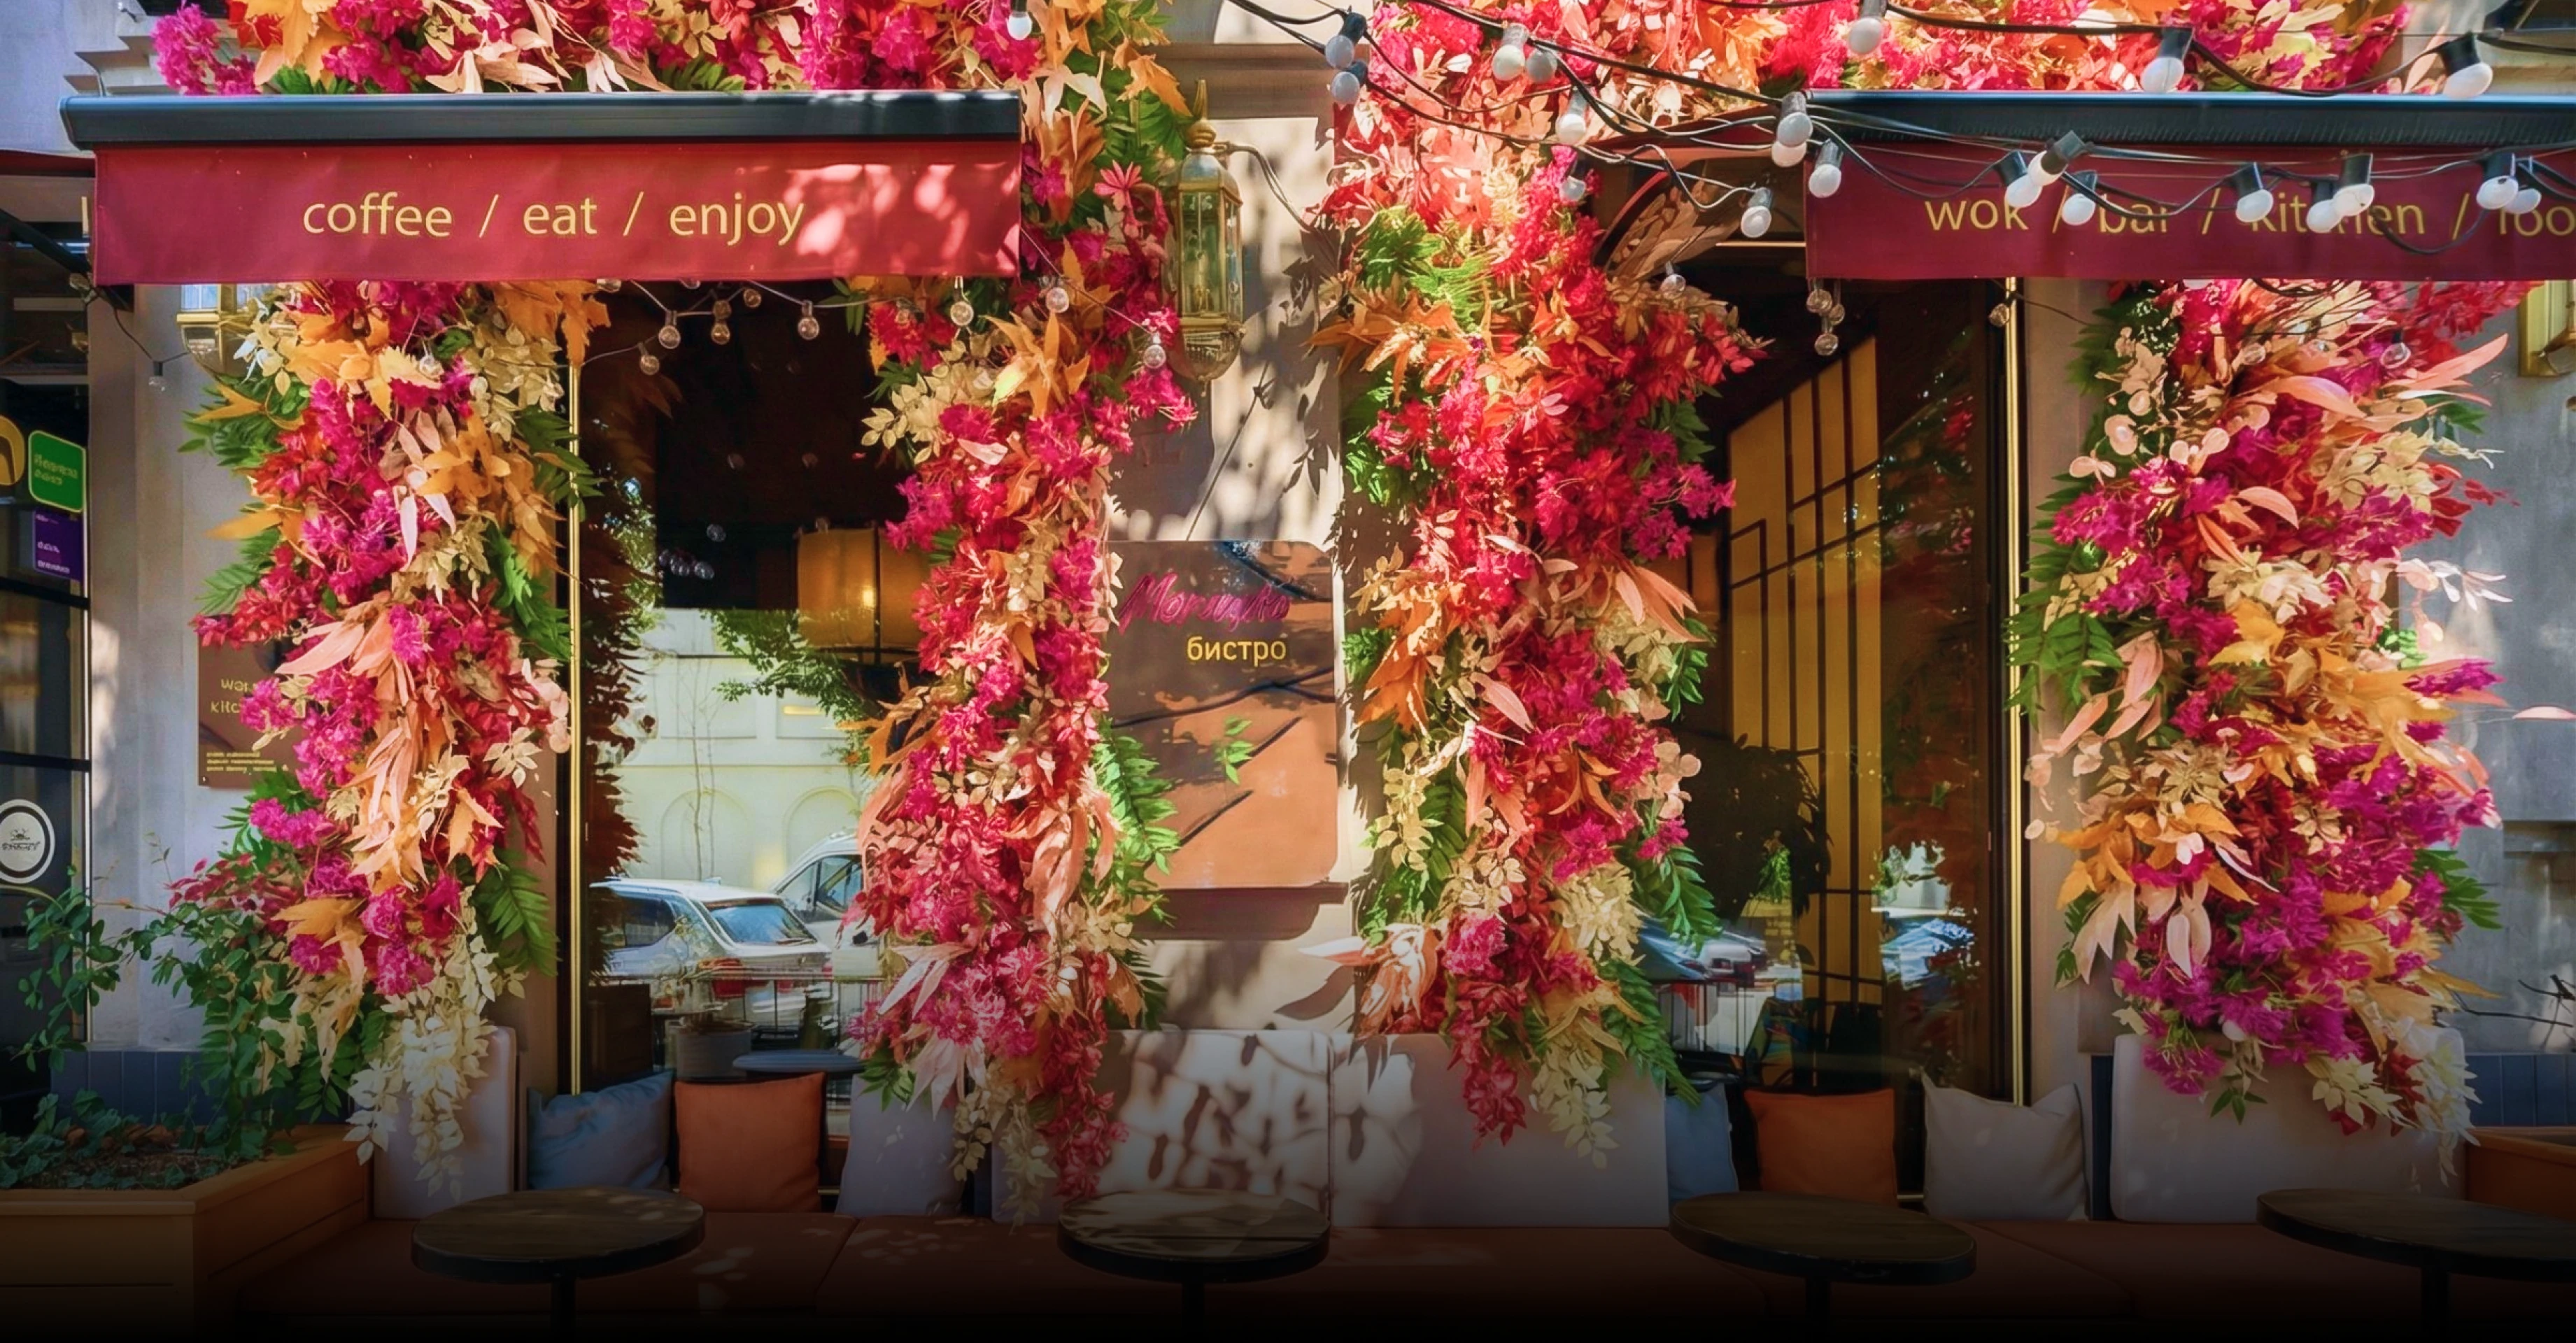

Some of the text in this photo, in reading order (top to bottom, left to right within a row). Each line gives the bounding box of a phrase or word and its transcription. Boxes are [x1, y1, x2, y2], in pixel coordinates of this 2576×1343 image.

[303, 192, 452, 238] coffee
[523, 199, 597, 235] eat
[670, 192, 805, 246] enjoy
[1925, 183, 2028, 231] wok
[2251, 191, 2426, 235] iten
[1187, 636, 1287, 667] бистро
